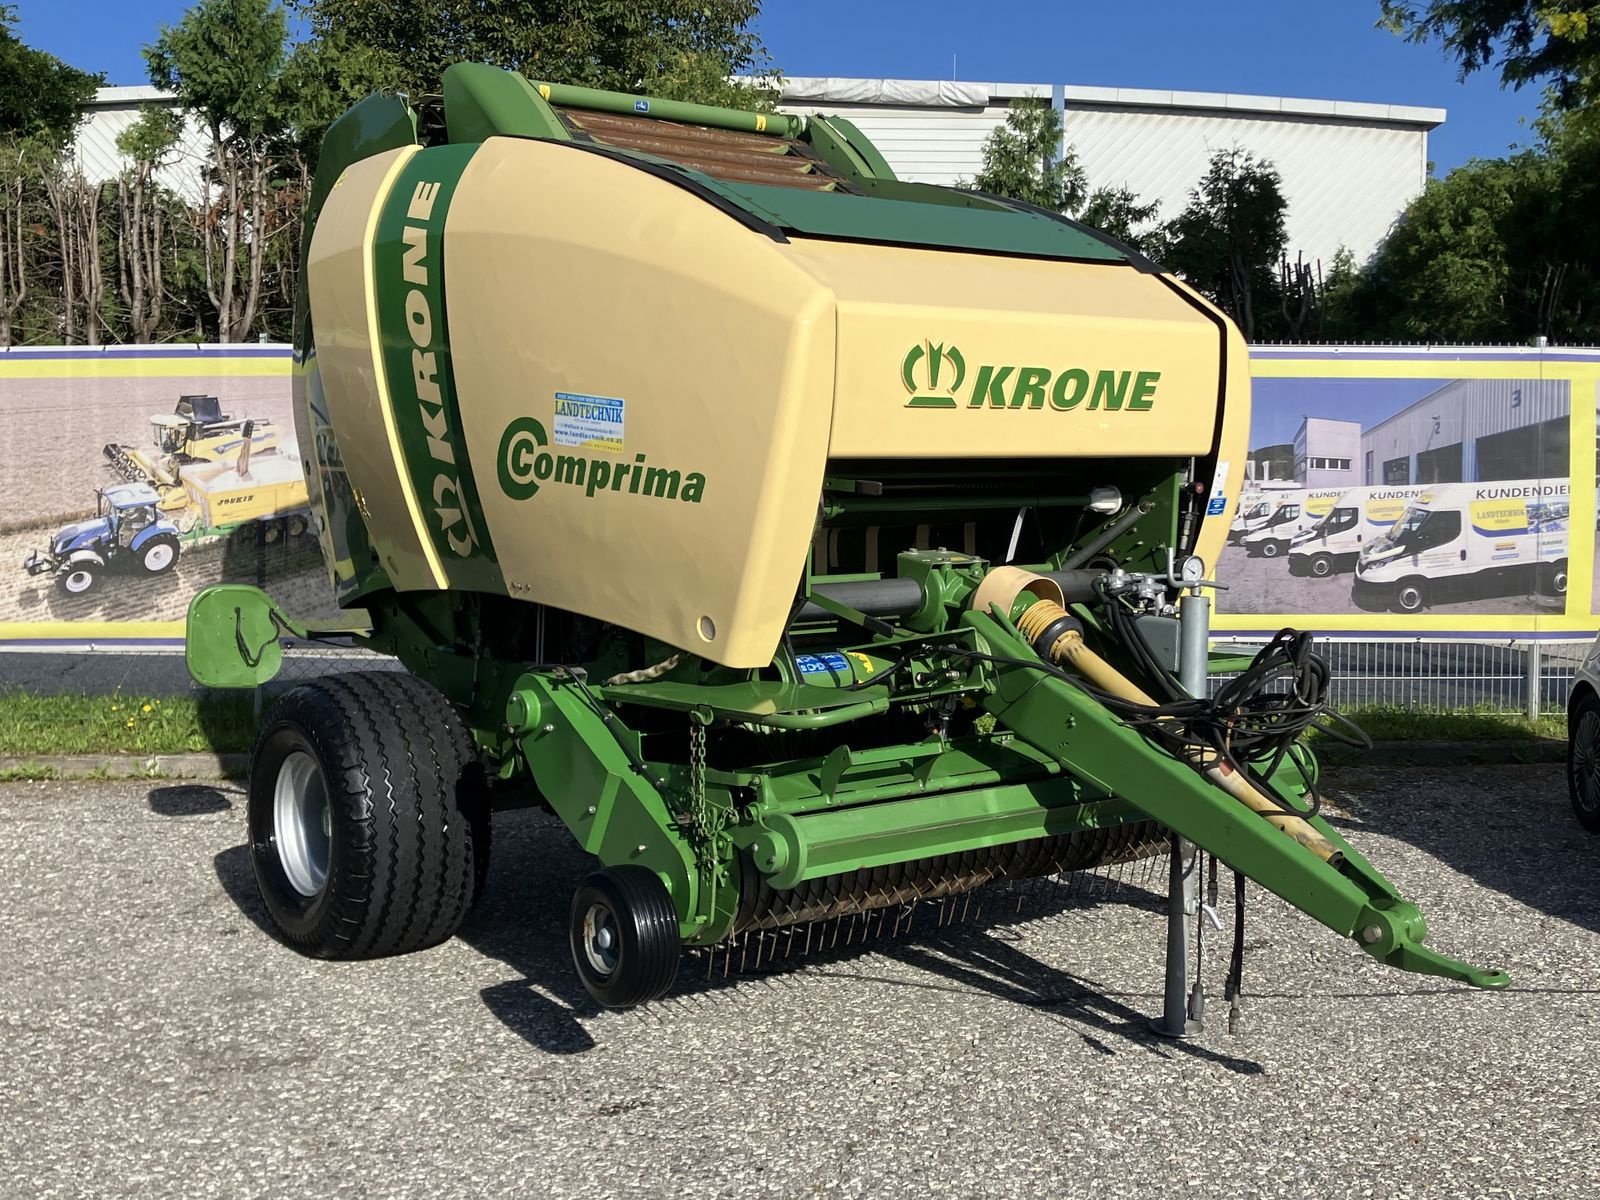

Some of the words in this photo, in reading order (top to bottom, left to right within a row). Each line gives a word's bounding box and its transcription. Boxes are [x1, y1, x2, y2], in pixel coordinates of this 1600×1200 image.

[402, 181, 455, 464] KRONE
[966, 365, 1161, 412] KRONE
[554, 401, 624, 424] LANDTECHNIK
[496, 416, 706, 504] Comprima
[1476, 485, 1570, 500] KUNDENDIE
